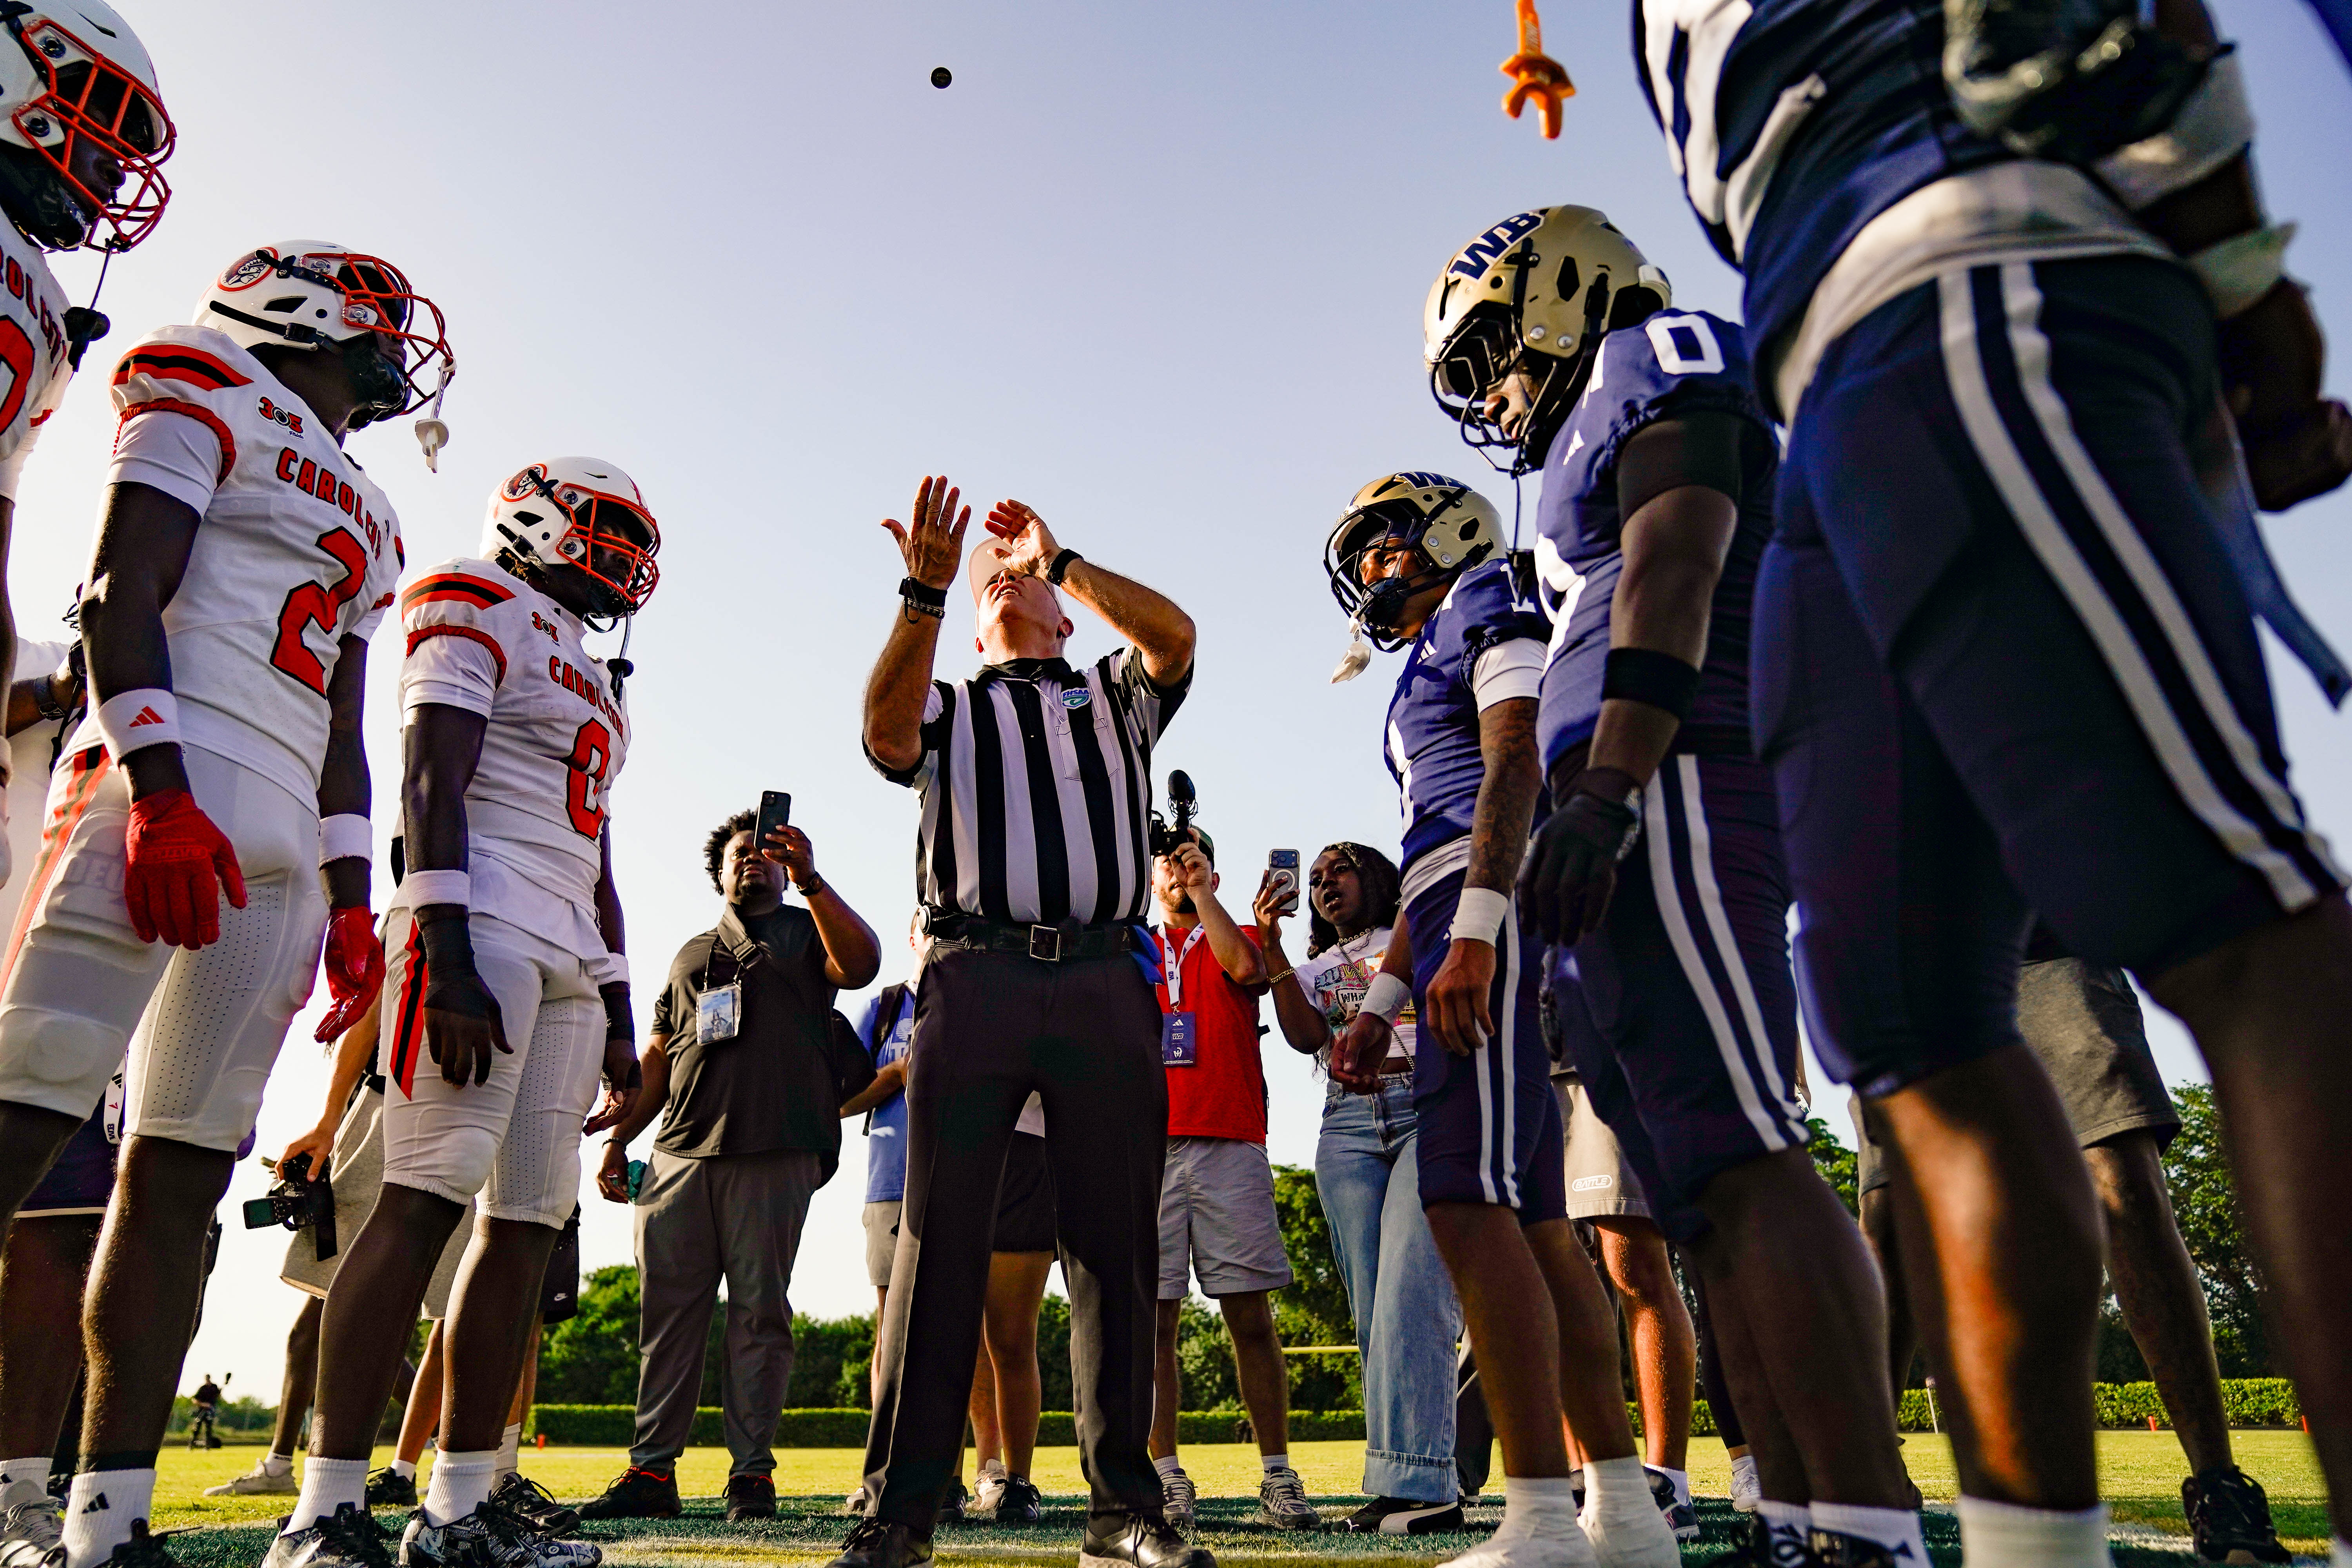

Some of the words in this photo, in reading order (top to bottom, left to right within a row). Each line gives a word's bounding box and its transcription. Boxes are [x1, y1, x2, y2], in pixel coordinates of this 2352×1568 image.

[1447, 213, 1543, 280] WB
[1646, 314, 1726, 375] 0
[258, 396, 304, 434] 305
[289, 431, 304, 439] Pride
[276, 446, 364, 530] CAROL
[270, 526, 367, 699] 2
[532, 611, 559, 642] 305
[549, 655, 606, 715] CAROL
[1063, 689, 1089, 698] FHSAA
[1168, 971, 1174, 981] WB
[1340, 992, 1367, 1004] WHa
[107, 1123, 116, 1140] WB
[1575, 1177, 1608, 1189] BATTLE
